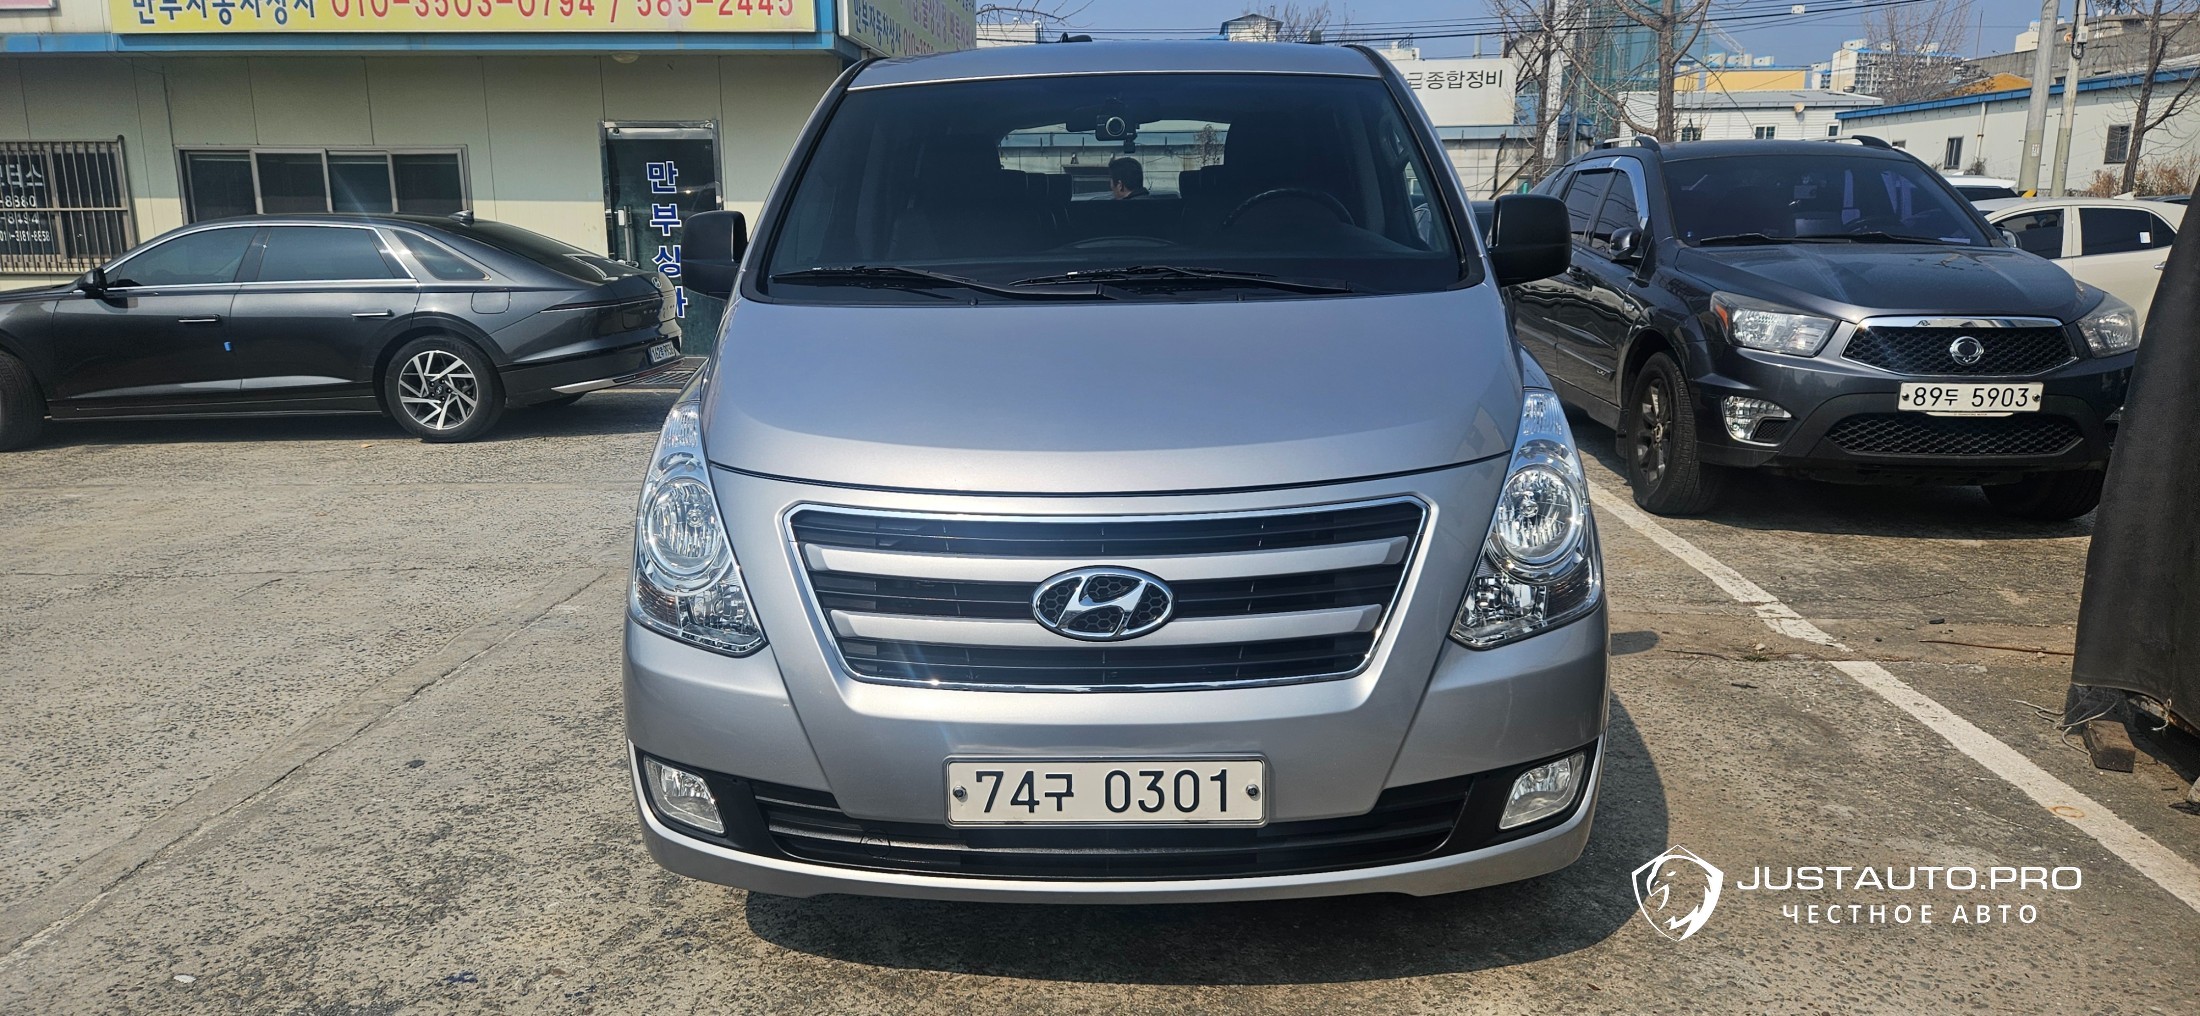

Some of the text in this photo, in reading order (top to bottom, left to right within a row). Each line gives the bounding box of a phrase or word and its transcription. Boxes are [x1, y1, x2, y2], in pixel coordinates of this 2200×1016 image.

[1401, 69, 1503, 90] 급종합정비
[1912, 386, 2030, 408] 89두 5903
[975, 768, 1228, 814] 74구 0301
